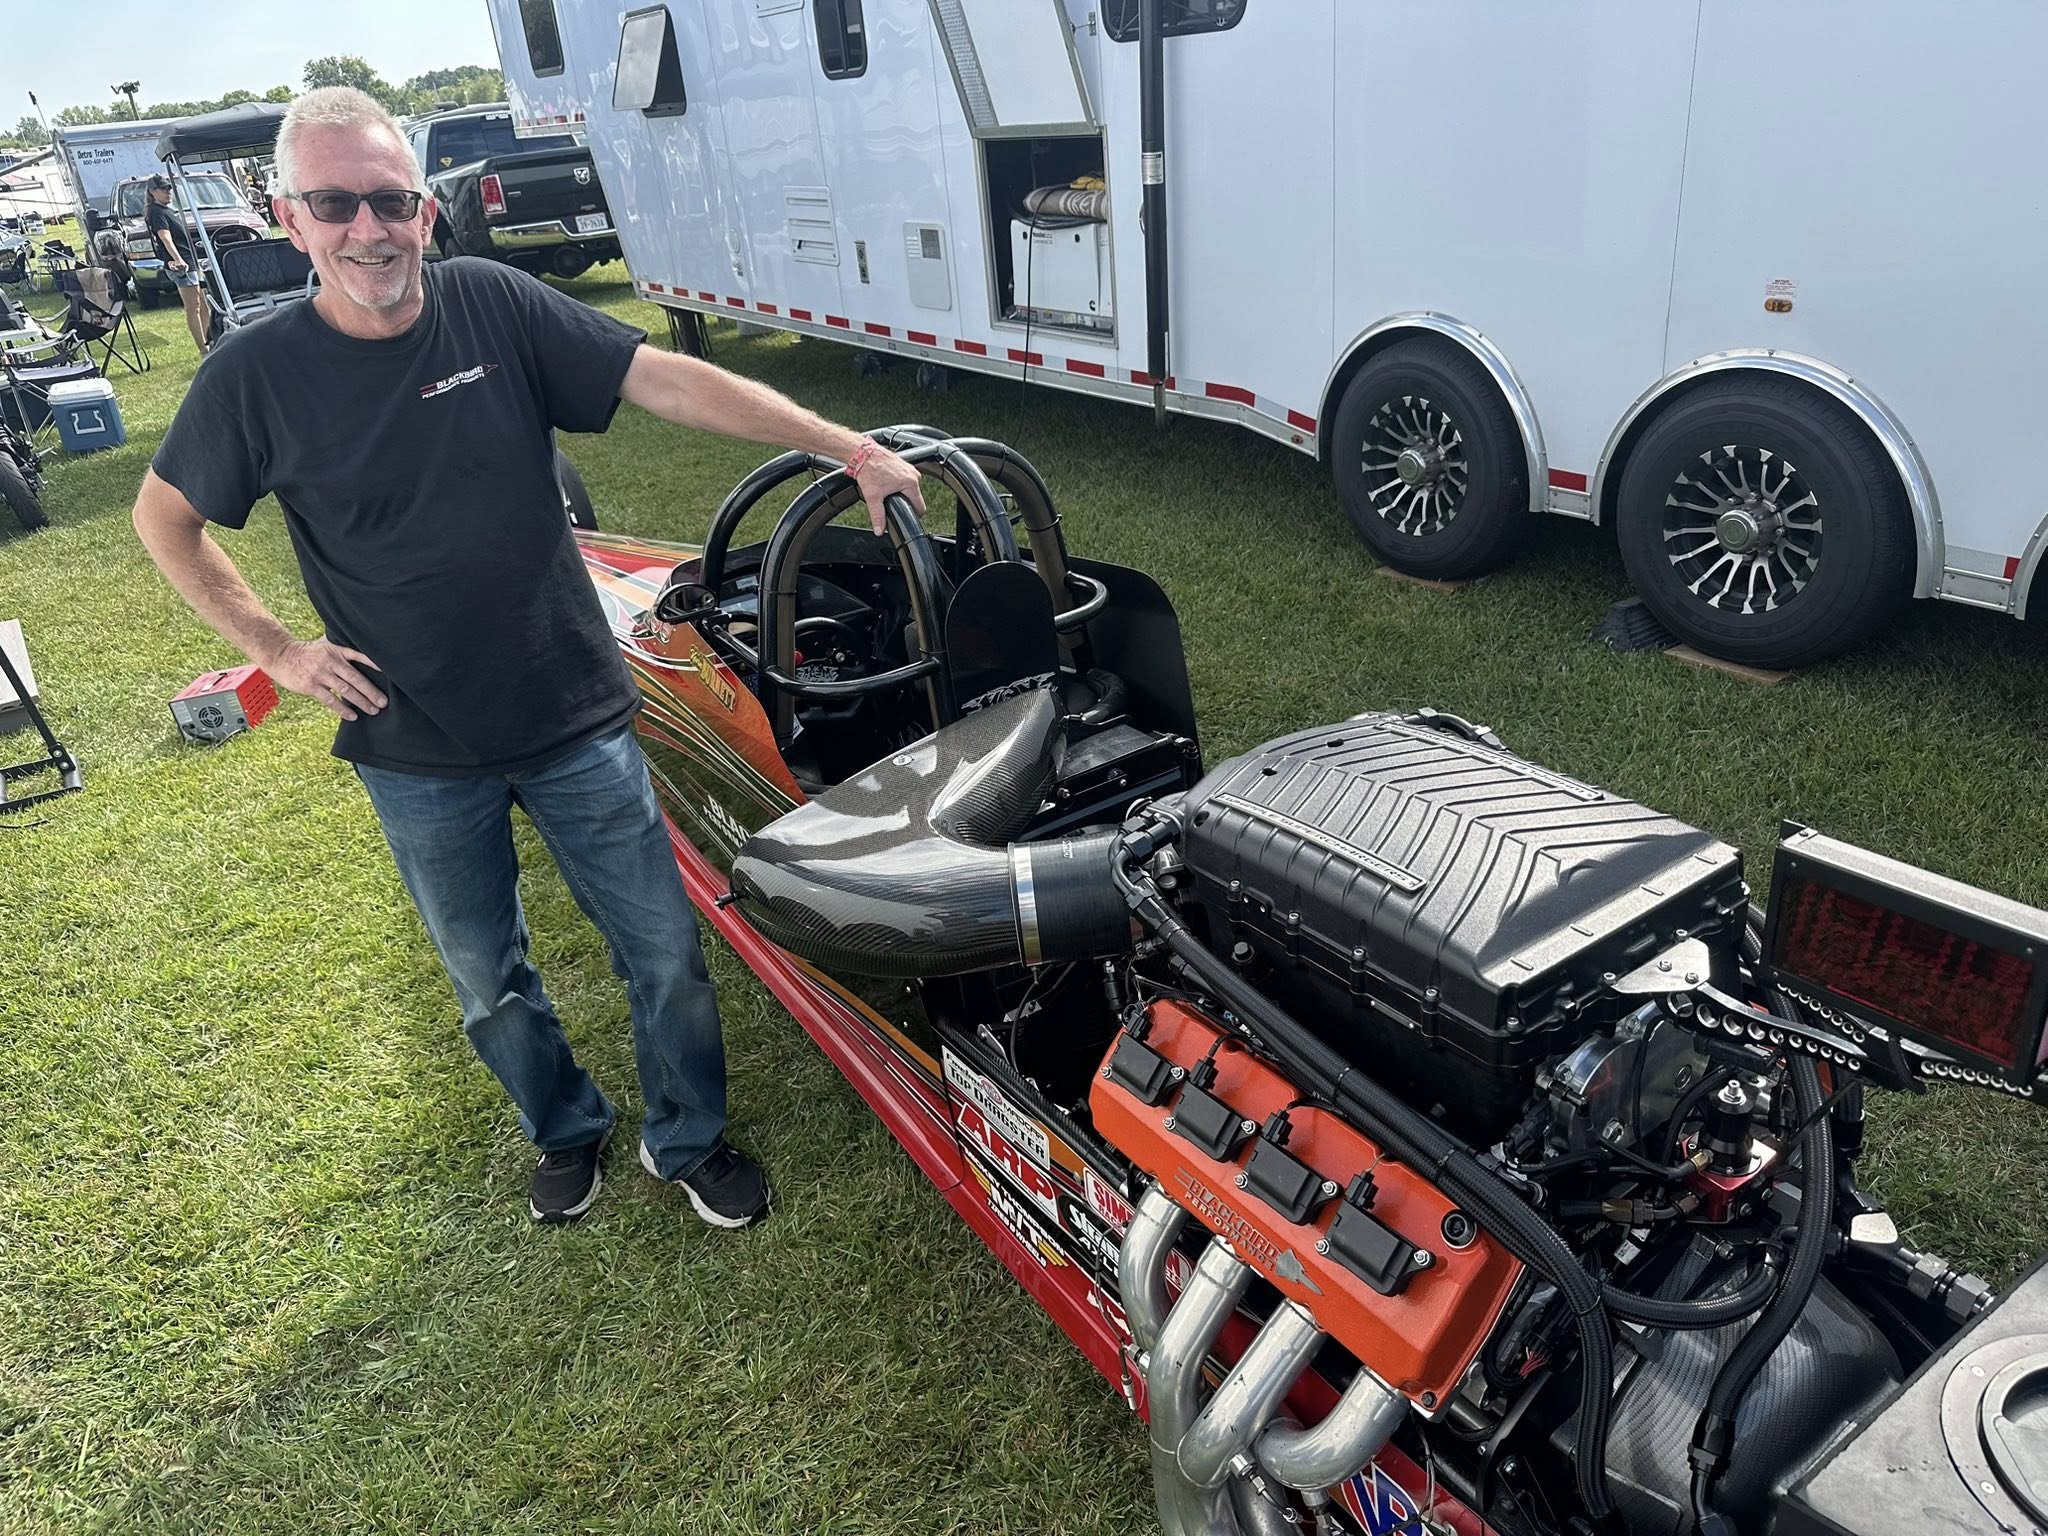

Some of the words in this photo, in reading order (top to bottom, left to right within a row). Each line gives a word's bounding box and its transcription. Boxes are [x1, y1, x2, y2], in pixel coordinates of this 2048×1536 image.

[94, 149, 115, 158] Trailers
[436, 365, 484, 390] BLACKBIRD
[703, 804, 743, 848] PERFORM
[1280, 817, 1409, 881] SUPERCHARGERS
[949, 1064, 971, 1090] TOP
[974, 1088, 1046, 1159] DRAGSTER
[961, 1106, 1054, 1201] ARP
[966, 1150, 1001, 1189] MICKEY
[1002, 1188, 1065, 1255] THOMPSON
[987, 1197, 1010, 1227] TIRES
[1015, 1230, 1047, 1267] WHEELS
[1093, 1180, 1133, 1223] SIM
[1184, 1191, 1275, 1271] PERFORMANCE
[1188, 1177, 1281, 1261] BLACKBIRD
